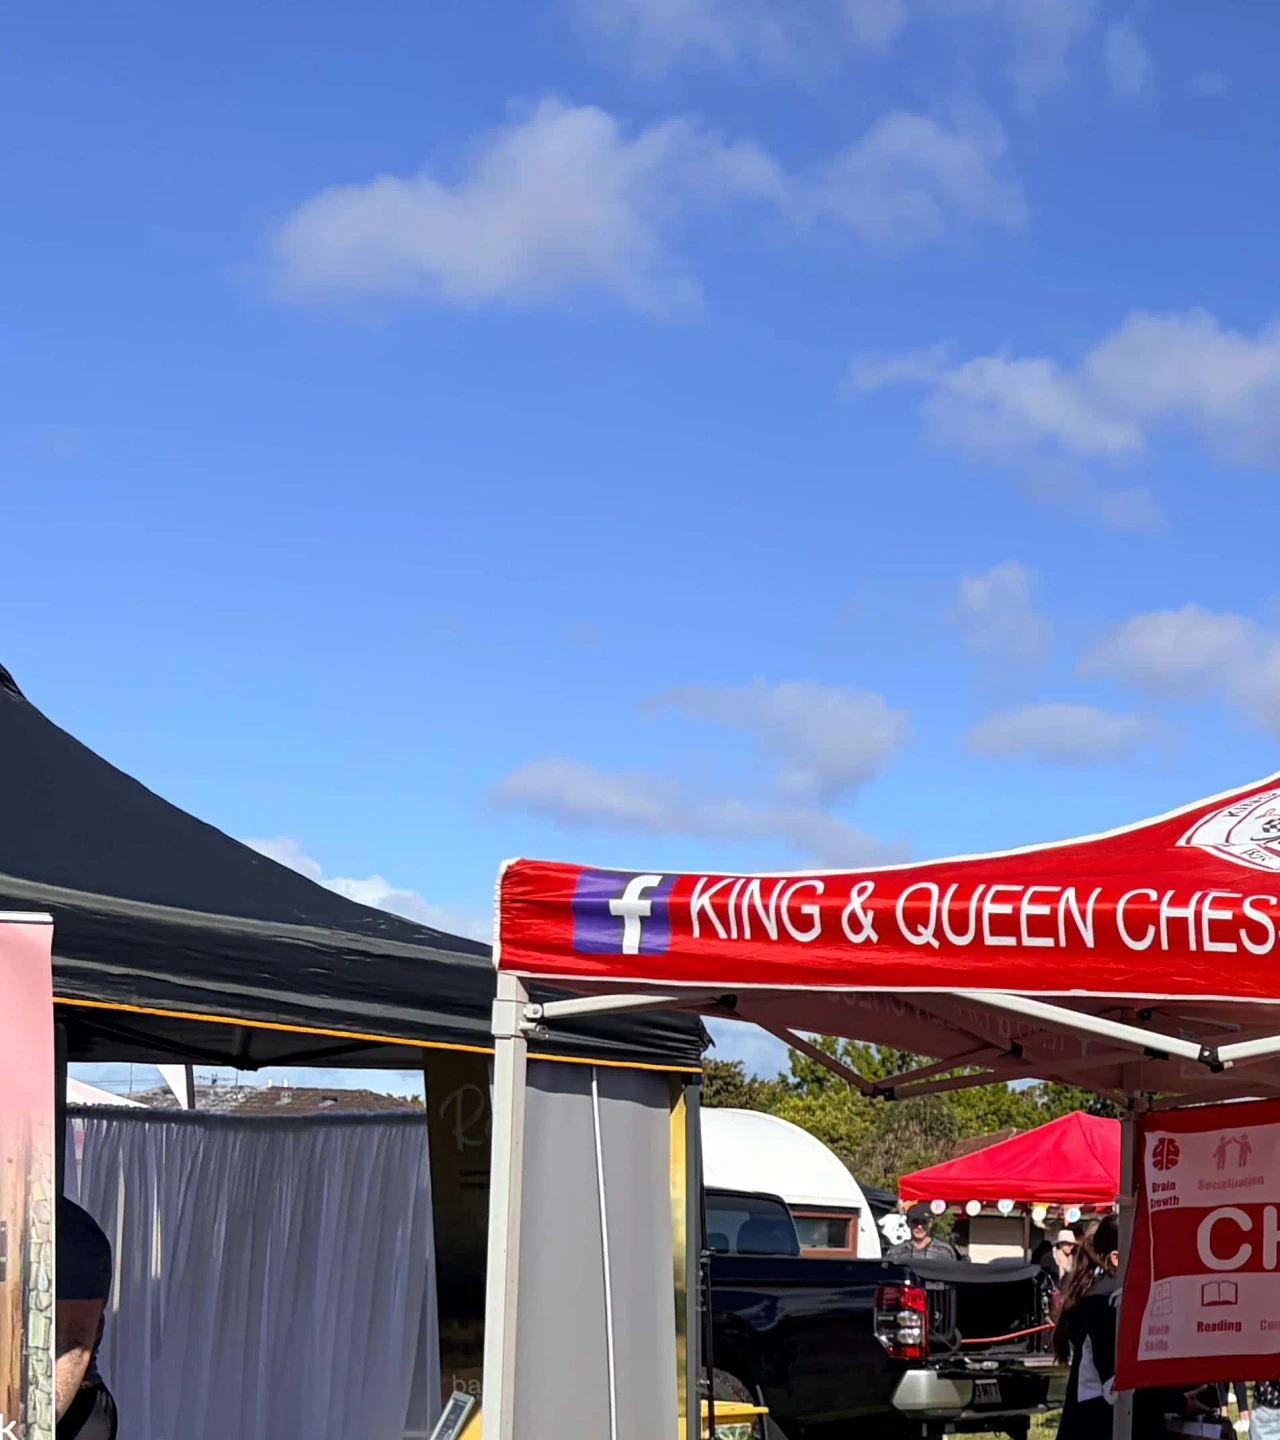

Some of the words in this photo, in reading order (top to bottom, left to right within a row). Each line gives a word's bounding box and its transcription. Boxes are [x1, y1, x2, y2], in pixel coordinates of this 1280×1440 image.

[689, 875, 826, 943] KING
[840, 880, 879, 945] &
[895, 881, 1102, 950] QUEEN
[1151, 1179, 1177, 1194] Brain
[1196, 1319, 1242, 1333] Reading
